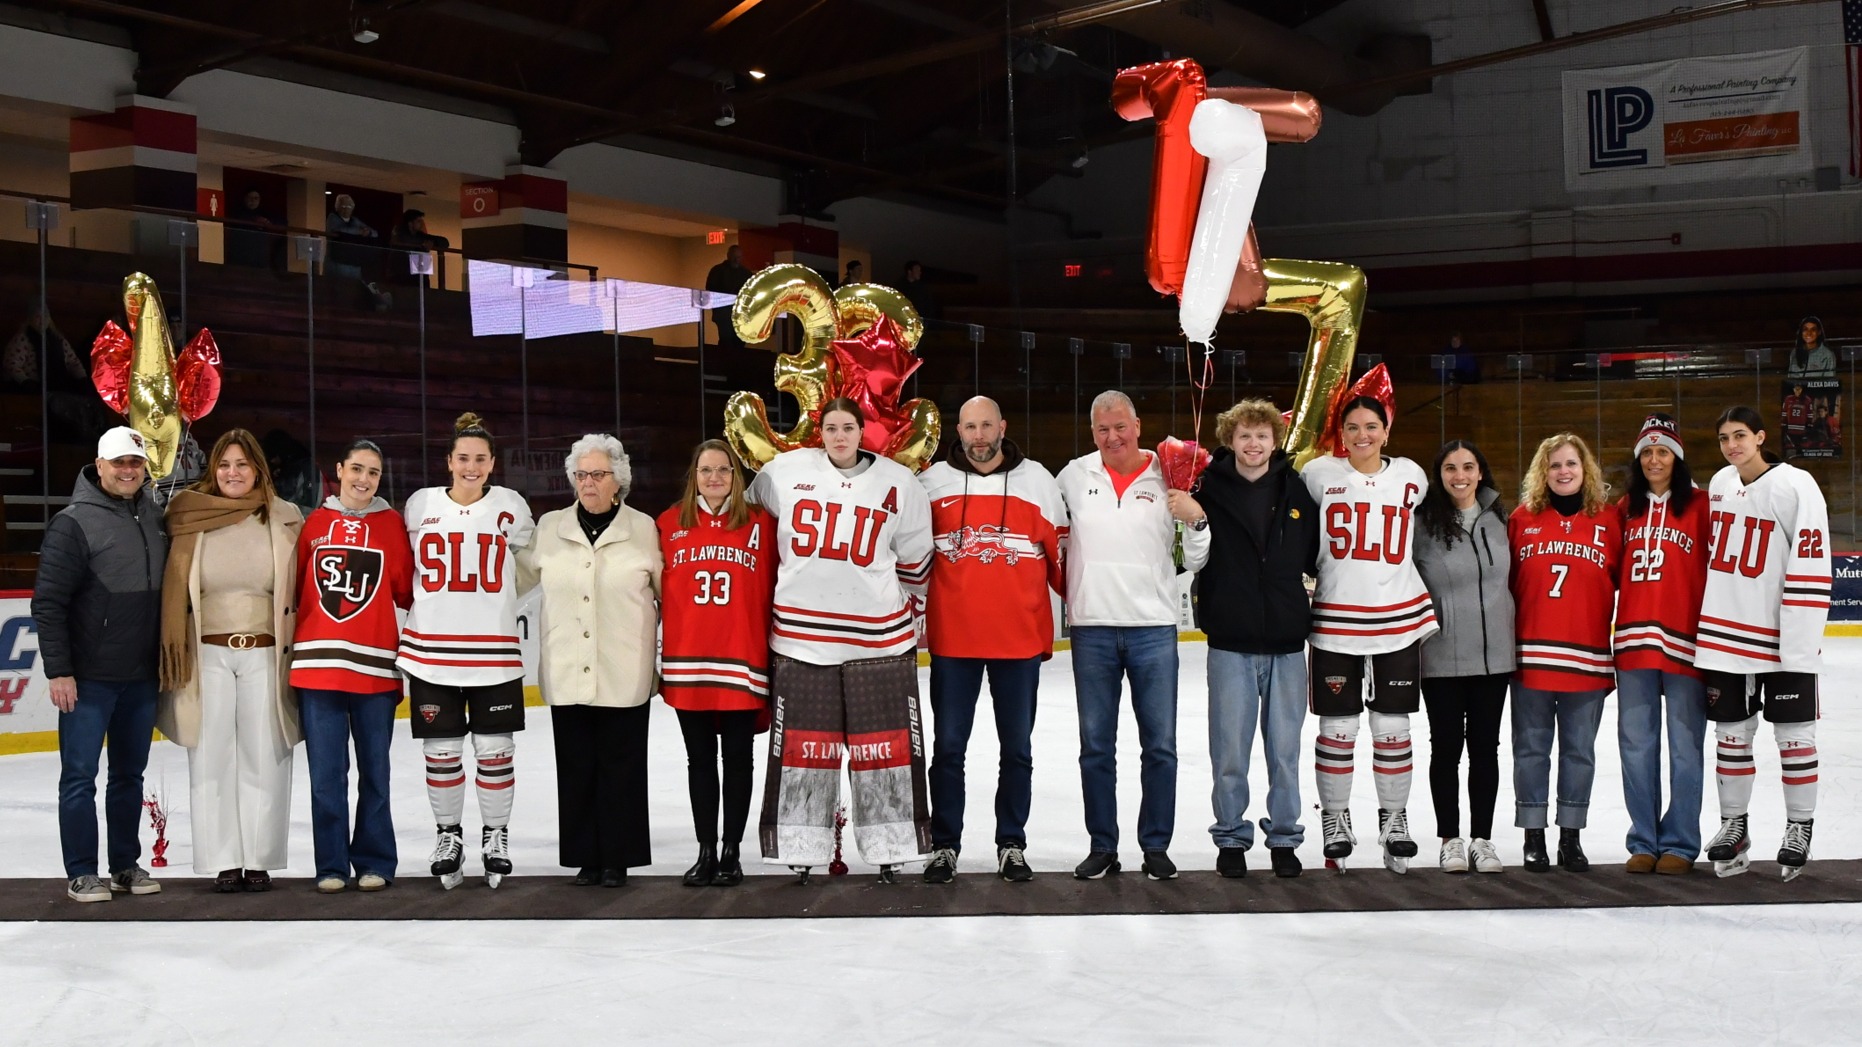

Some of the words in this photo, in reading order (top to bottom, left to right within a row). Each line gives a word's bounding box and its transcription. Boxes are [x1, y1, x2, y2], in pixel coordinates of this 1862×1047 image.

[1678, 81, 1726, 96] Professional
[1727, 78, 1758, 90] Painting
[1761, 75, 1798, 87] Company
[1733, 123, 1780, 140] Painting
[465, 186, 494, 196] SECTION
[708, 231, 724, 245] EXIT
[1065, 265, 1081, 277] EXIT
[882, 486, 898, 514] A
[1404, 482, 1419, 509] C
[497, 511, 515, 538] C
[747, 523, 760, 551] A
[791, 498, 888, 568] SLU
[1326, 502, 1410, 566] SLU
[1520, 544, 1534, 562] ST.
[1537, 541, 1606, 569] LAWRENCE
[1798, 529, 1824, 559] 22
[419, 532, 507, 593] SLU
[672, 547, 688, 568] ST.
[690, 545, 758, 573] LAWRENCE
[1631, 549, 1665, 582] 22
[320, 556, 370, 602] SLU
[693, 570, 731, 606] 33
[1549, 564, 1569, 598] 7
[489, 704, 513, 712] CCM
[802, 741, 818, 759] ST.
